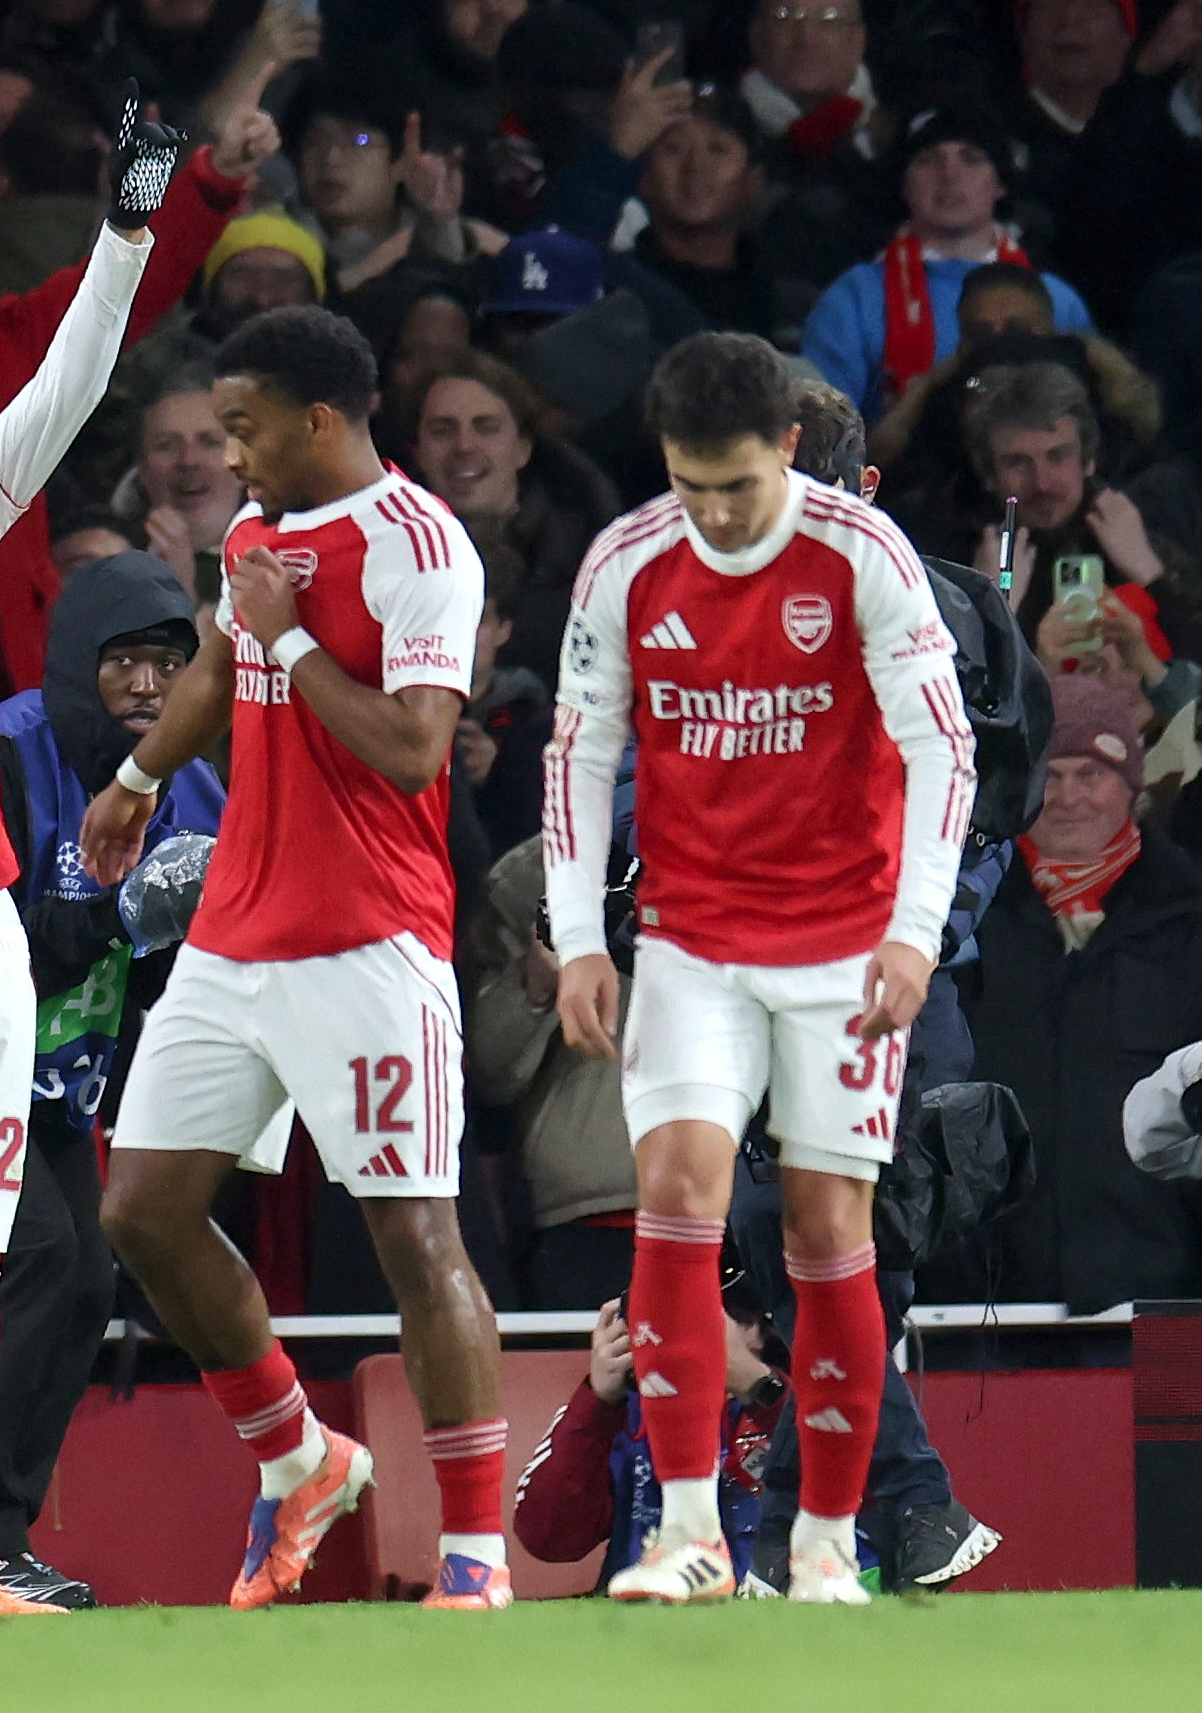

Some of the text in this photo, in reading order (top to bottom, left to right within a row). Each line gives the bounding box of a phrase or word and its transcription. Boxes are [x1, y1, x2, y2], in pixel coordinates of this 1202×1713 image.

[386, 652, 461, 674] RWANDA
[646, 680, 834, 724] Emirates
[680, 719, 806, 761] FLY BETTER
[348, 1054, 414, 1134] 12
